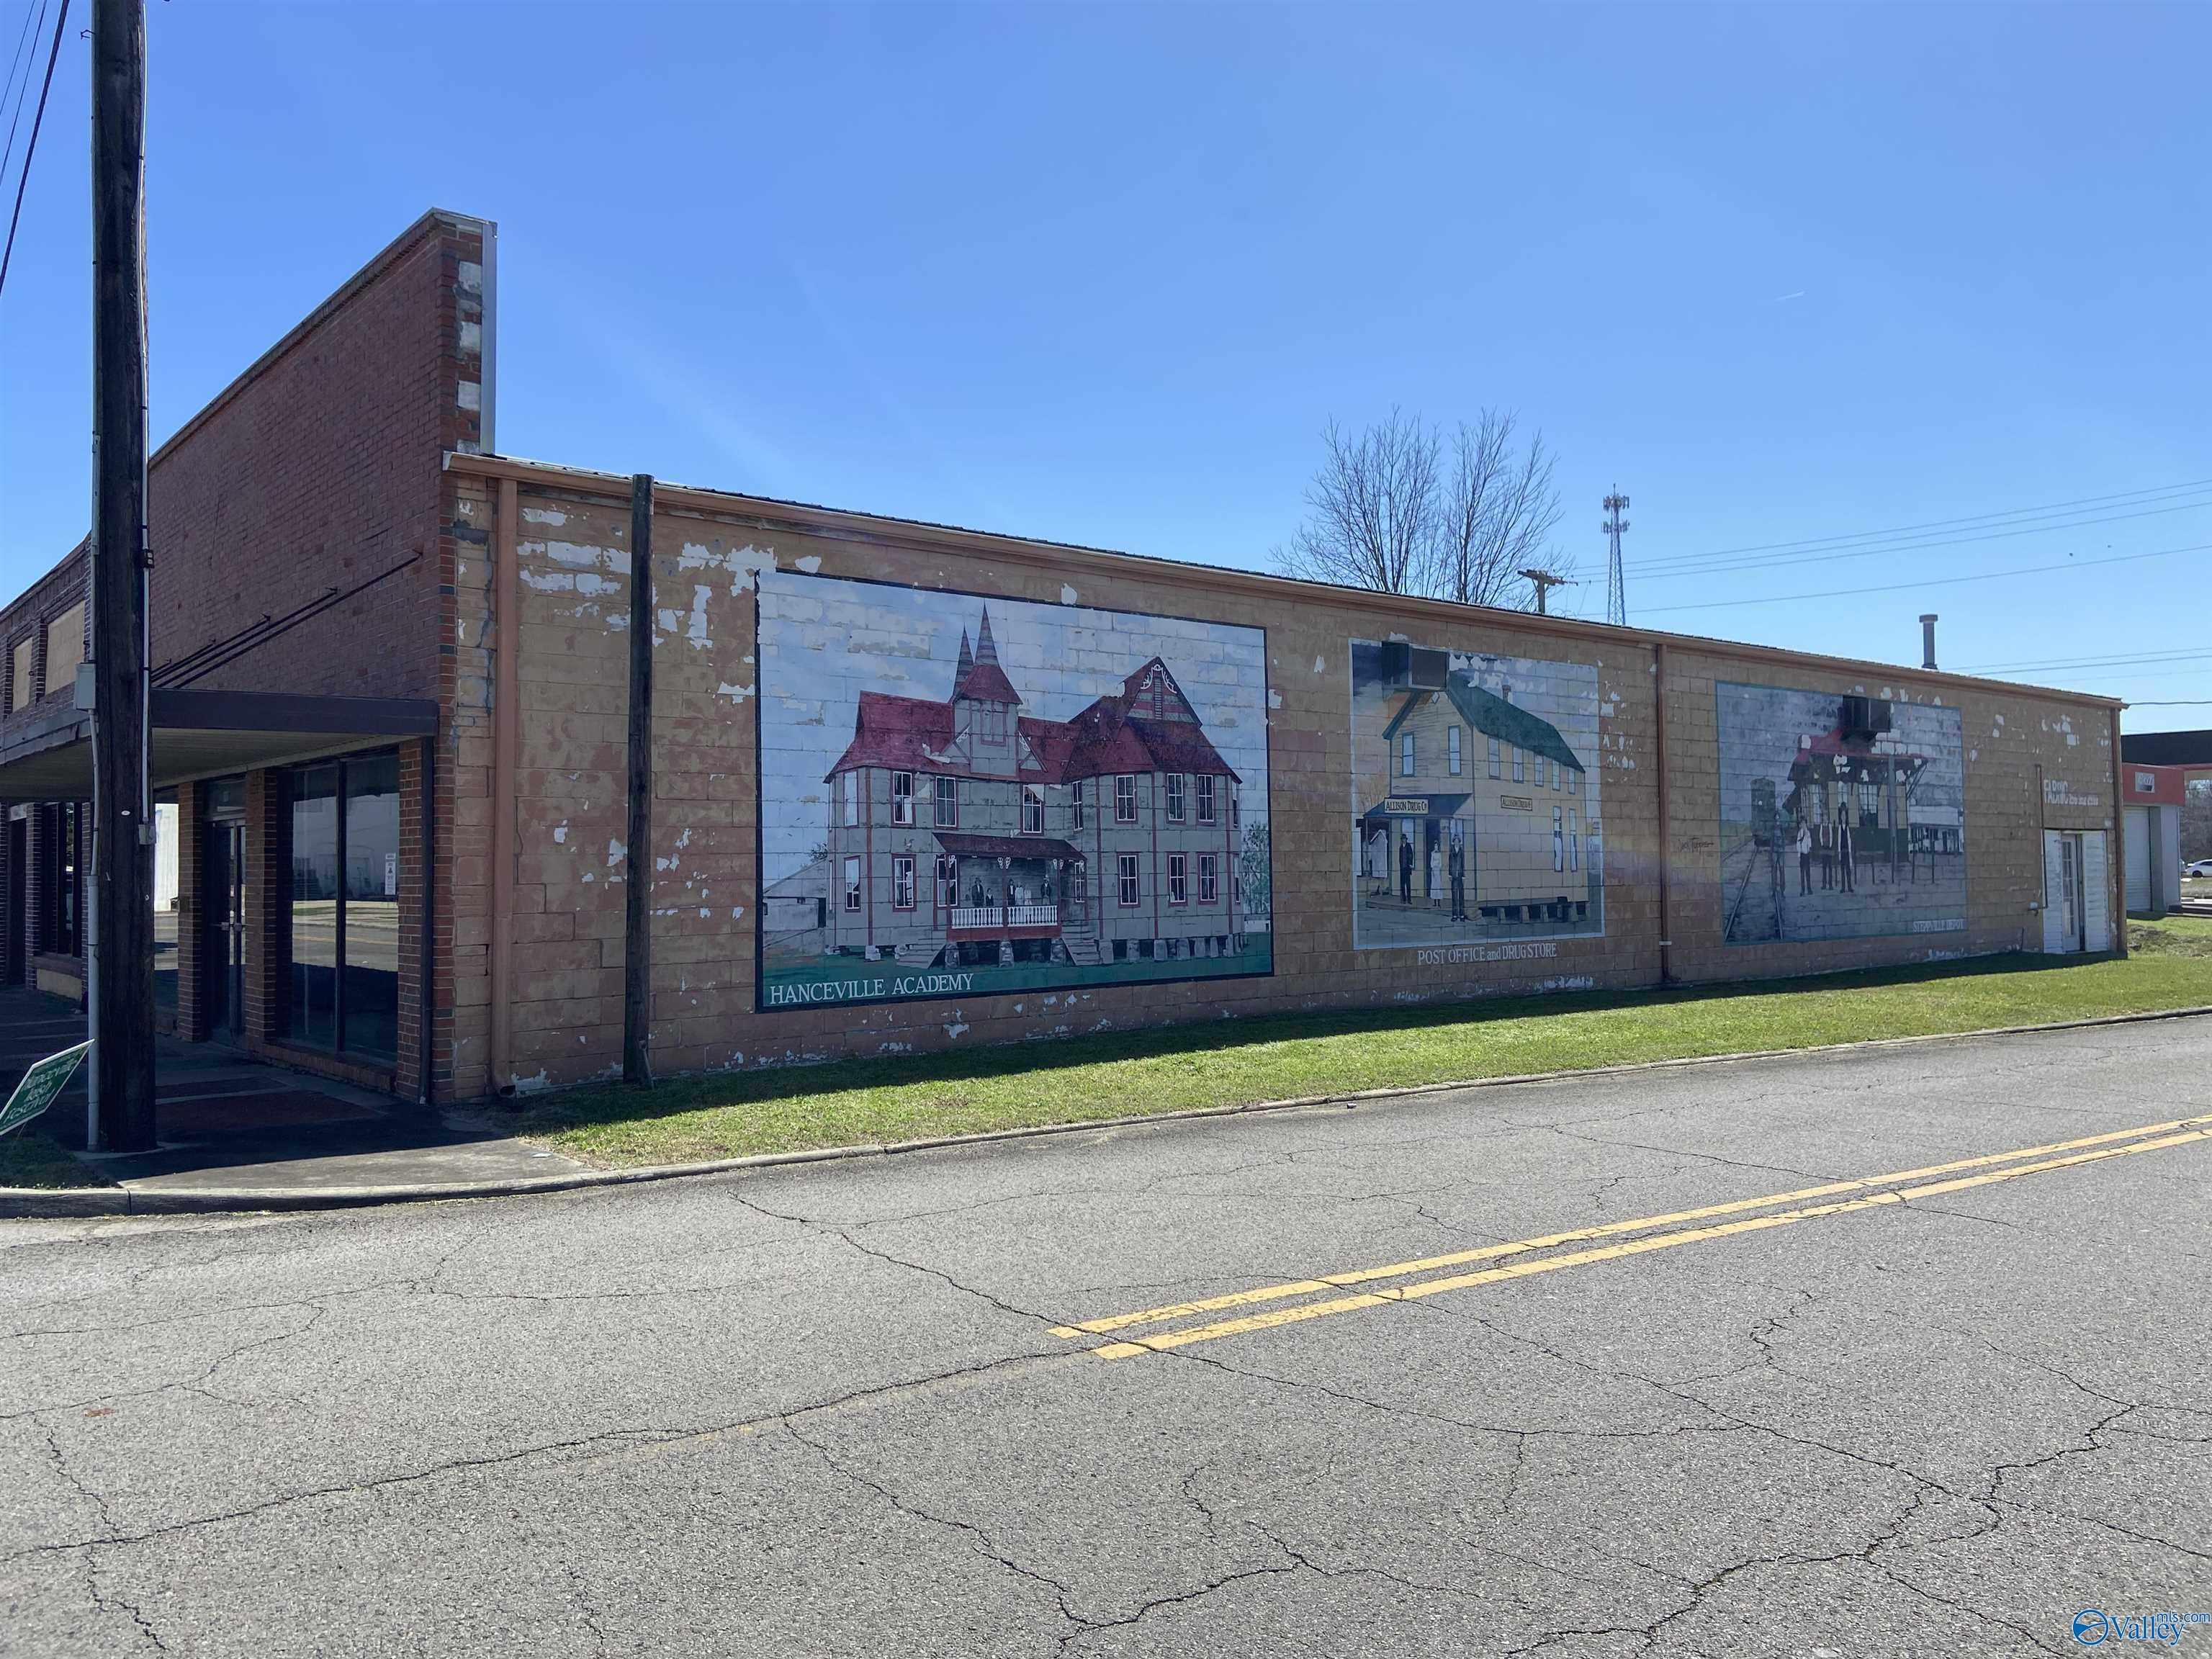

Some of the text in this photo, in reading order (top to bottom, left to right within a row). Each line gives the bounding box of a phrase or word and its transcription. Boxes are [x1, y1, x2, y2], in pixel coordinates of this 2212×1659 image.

[1418, 943, 1557, 965] POST OFFICE and DRUG STORE
[769, 973, 974, 1004] HANCEVILLE ACADEMY
